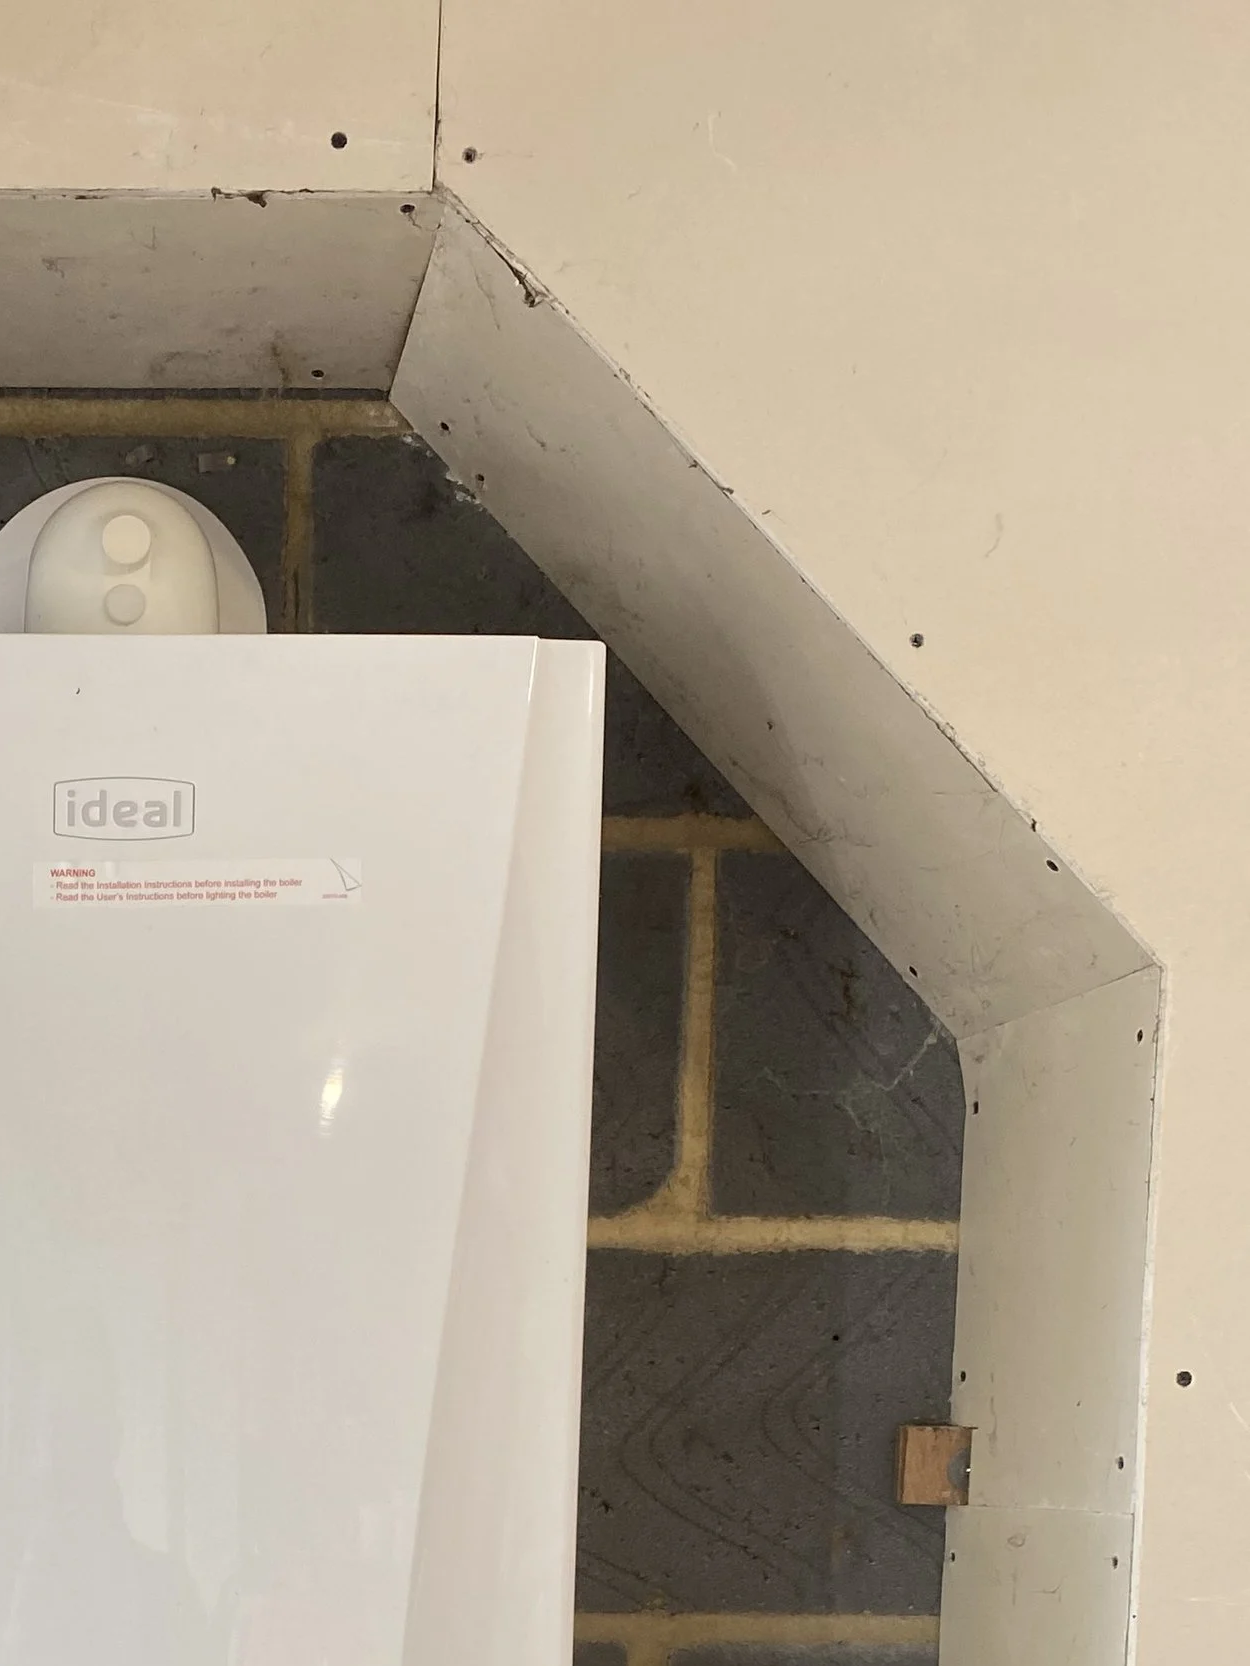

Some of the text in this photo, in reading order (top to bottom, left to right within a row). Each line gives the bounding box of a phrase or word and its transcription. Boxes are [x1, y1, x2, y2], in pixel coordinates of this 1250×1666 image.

[66, 789, 183, 828] ideal
[50, 869, 96, 878] WARNING
[56, 878, 302, 890] Read the Installation Instructions before installing the boiler
[56, 890, 278, 901] Read the User's Instructions before lighting the boiler
